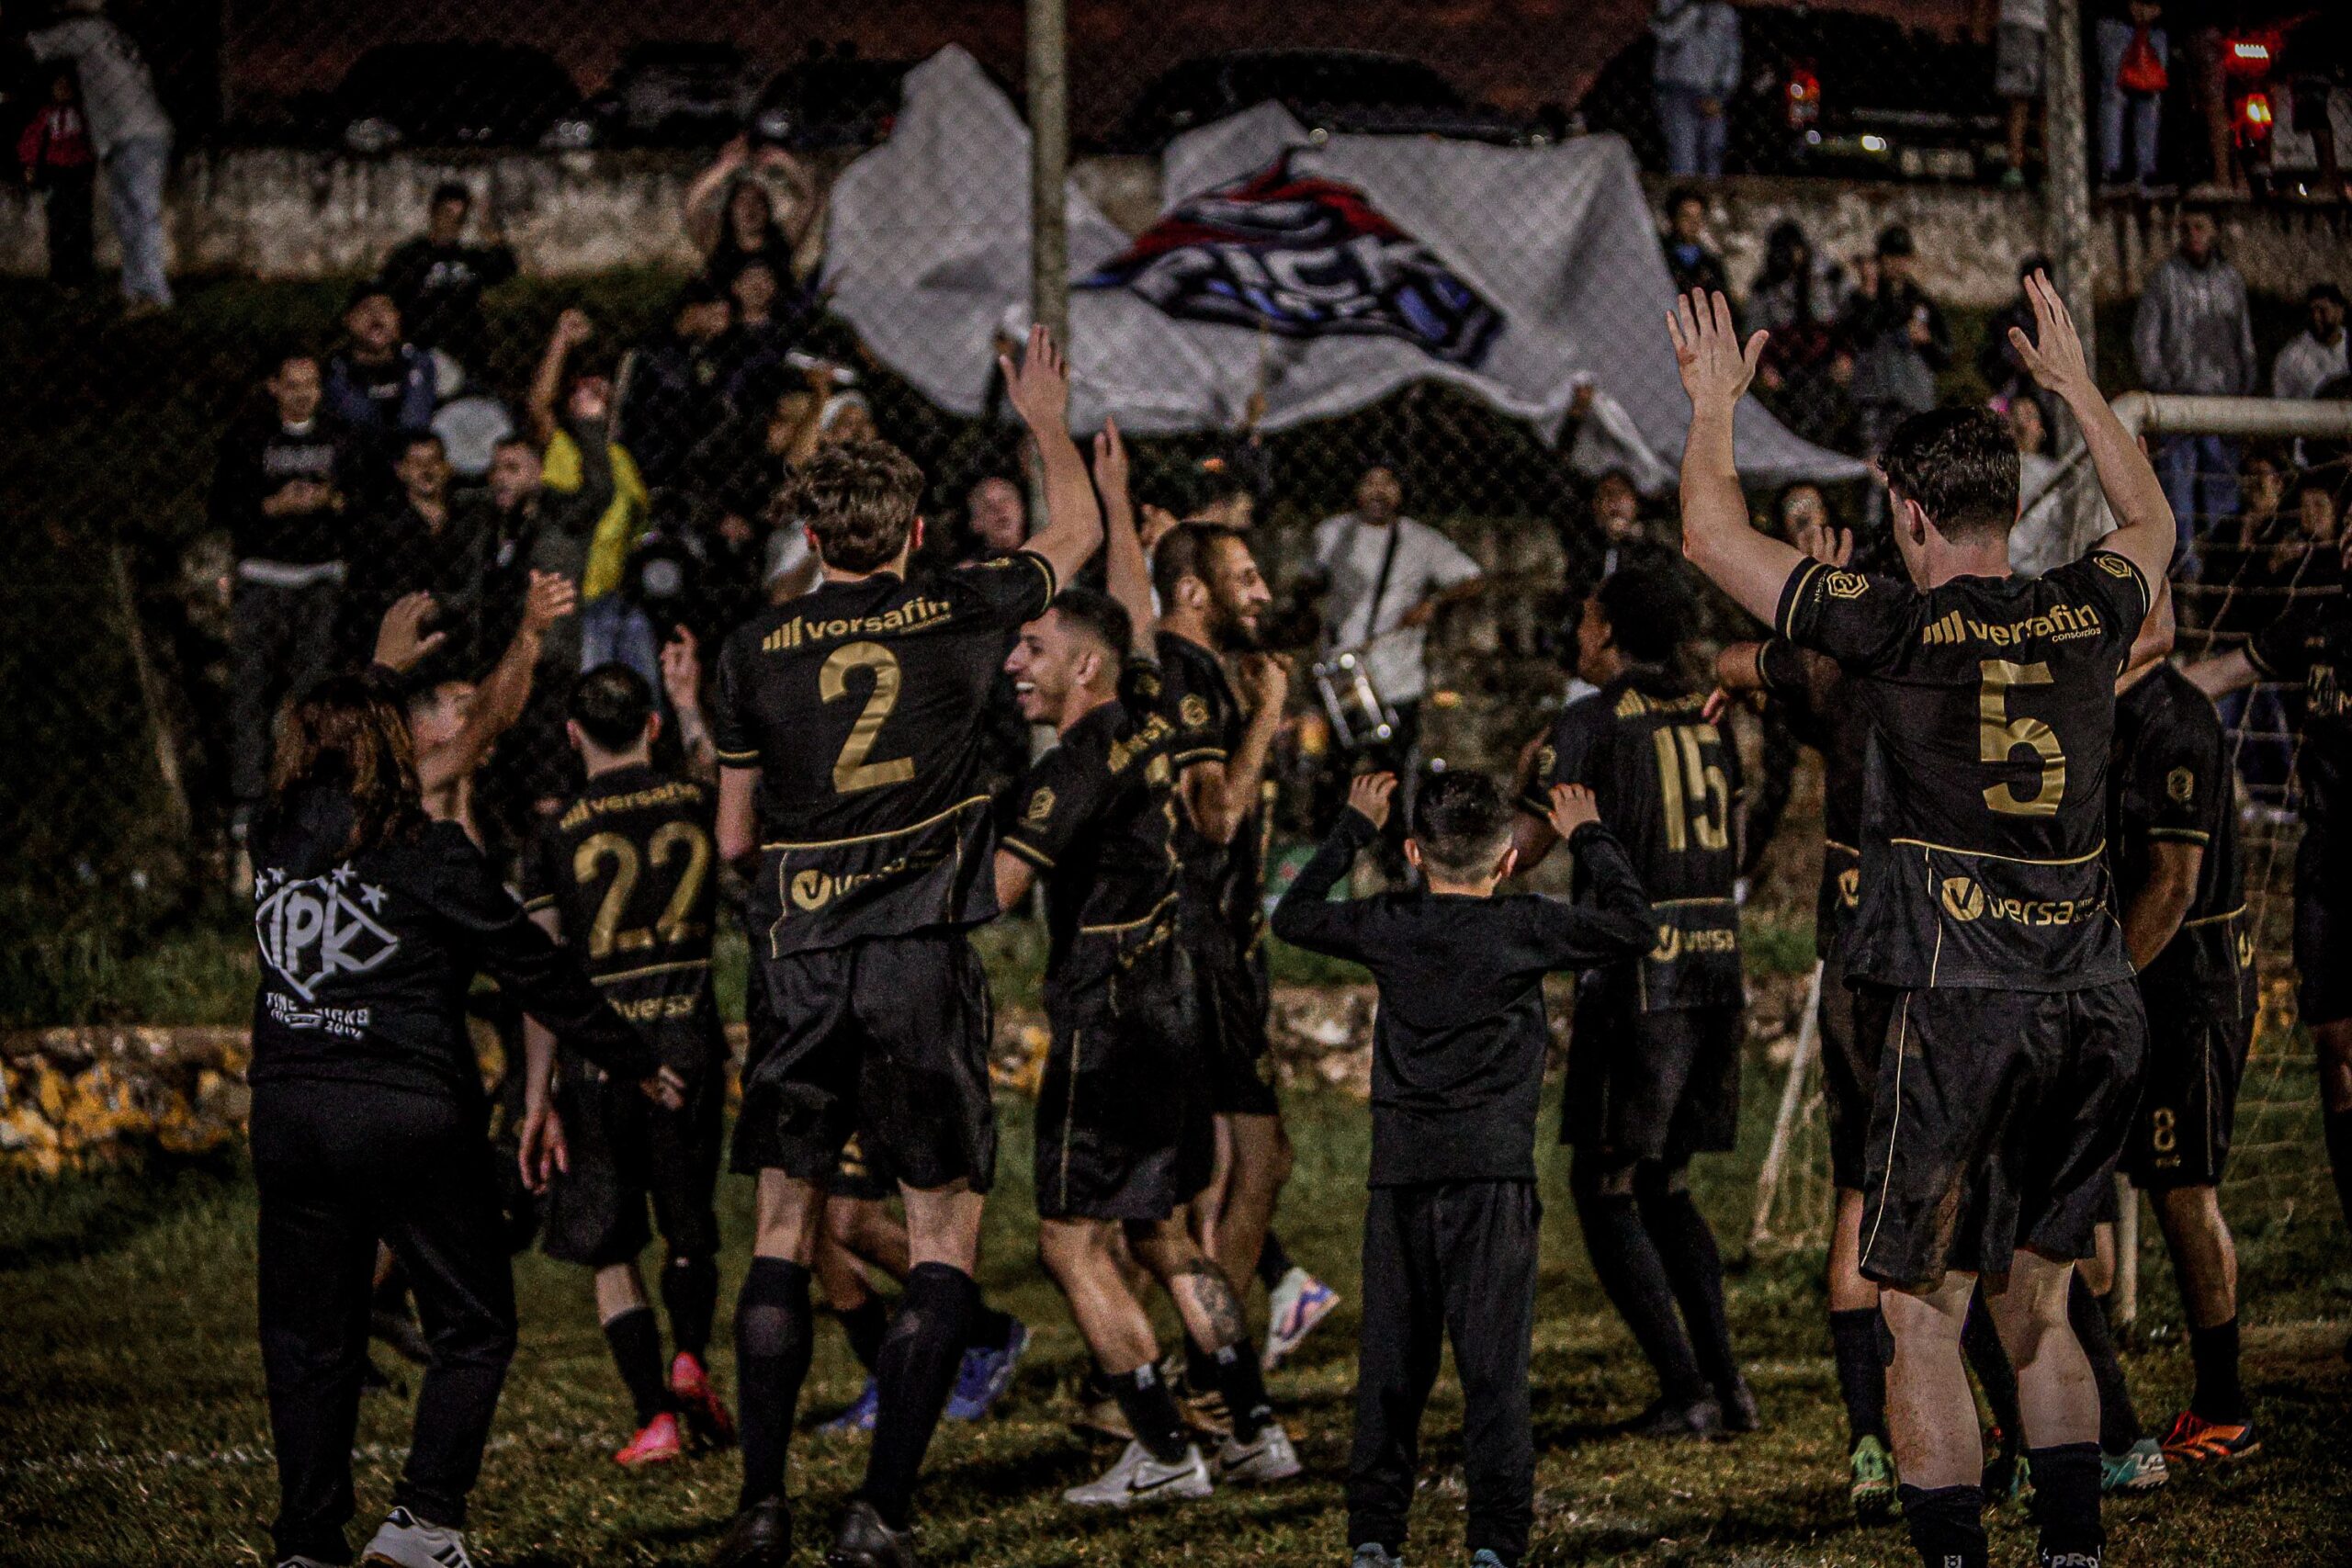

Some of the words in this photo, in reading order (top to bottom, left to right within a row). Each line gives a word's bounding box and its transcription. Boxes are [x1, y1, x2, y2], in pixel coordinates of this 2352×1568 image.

[819, 640, 915, 794] 2
[1979, 658, 2066, 816] 5
[1654, 723, 1728, 852] 15
[572, 820, 713, 962] 22
[1986, 894, 2075, 926] versa
[2152, 1105, 2177, 1153] 8
